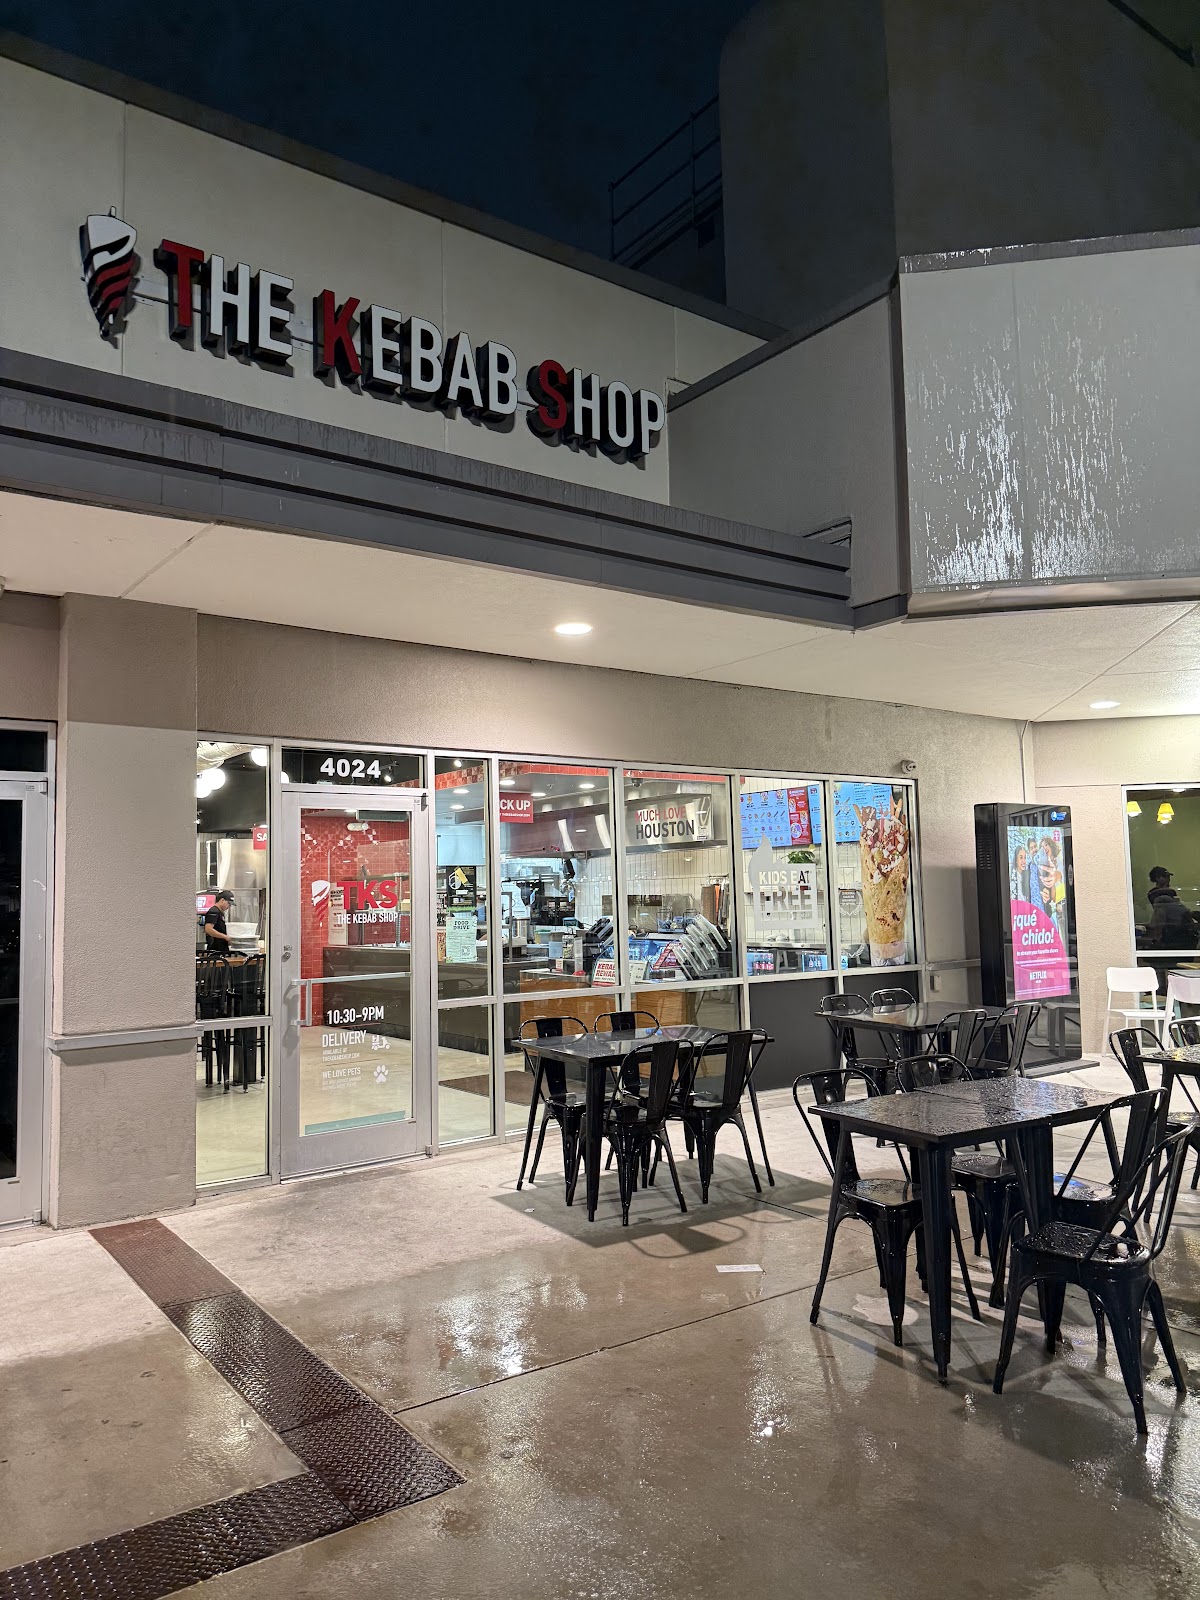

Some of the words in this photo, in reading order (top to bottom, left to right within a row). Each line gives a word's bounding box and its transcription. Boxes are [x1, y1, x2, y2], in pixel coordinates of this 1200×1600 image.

[161, 238, 294, 357] THE
[320, 288, 518, 417] KEBAB
[537, 358, 666, 457] SHOP
[320, 757, 381, 778] 4024
[499, 798, 515, 811] CK
[516, 799, 531, 811] UP
[635, 809, 660, 823] MUCH
[663, 805, 686, 820] LOVE
[256, 832, 267, 842] SA
[636, 819, 695, 840] HOUSTON
[759, 871, 787, 885] KIDS
[790, 871, 809, 884] EAT
[337, 880, 398, 910] TKS
[760, 886, 812, 911] FREE
[337, 914, 351, 925] THE
[353, 913, 377, 924] KEBAB
[379, 912, 398, 923] SHOP
[1013, 909, 1037, 931] ¡qué
[1022, 927, 1054, 946] chido!
[1030, 971, 1047, 980] NETFLIX
[322, 1030, 367, 1048] DELIVERY
[322, 1070, 332, 1079] WE
[333, 1069, 347, 1078] LOVE
[348, 1067, 361, 1076] PETS
